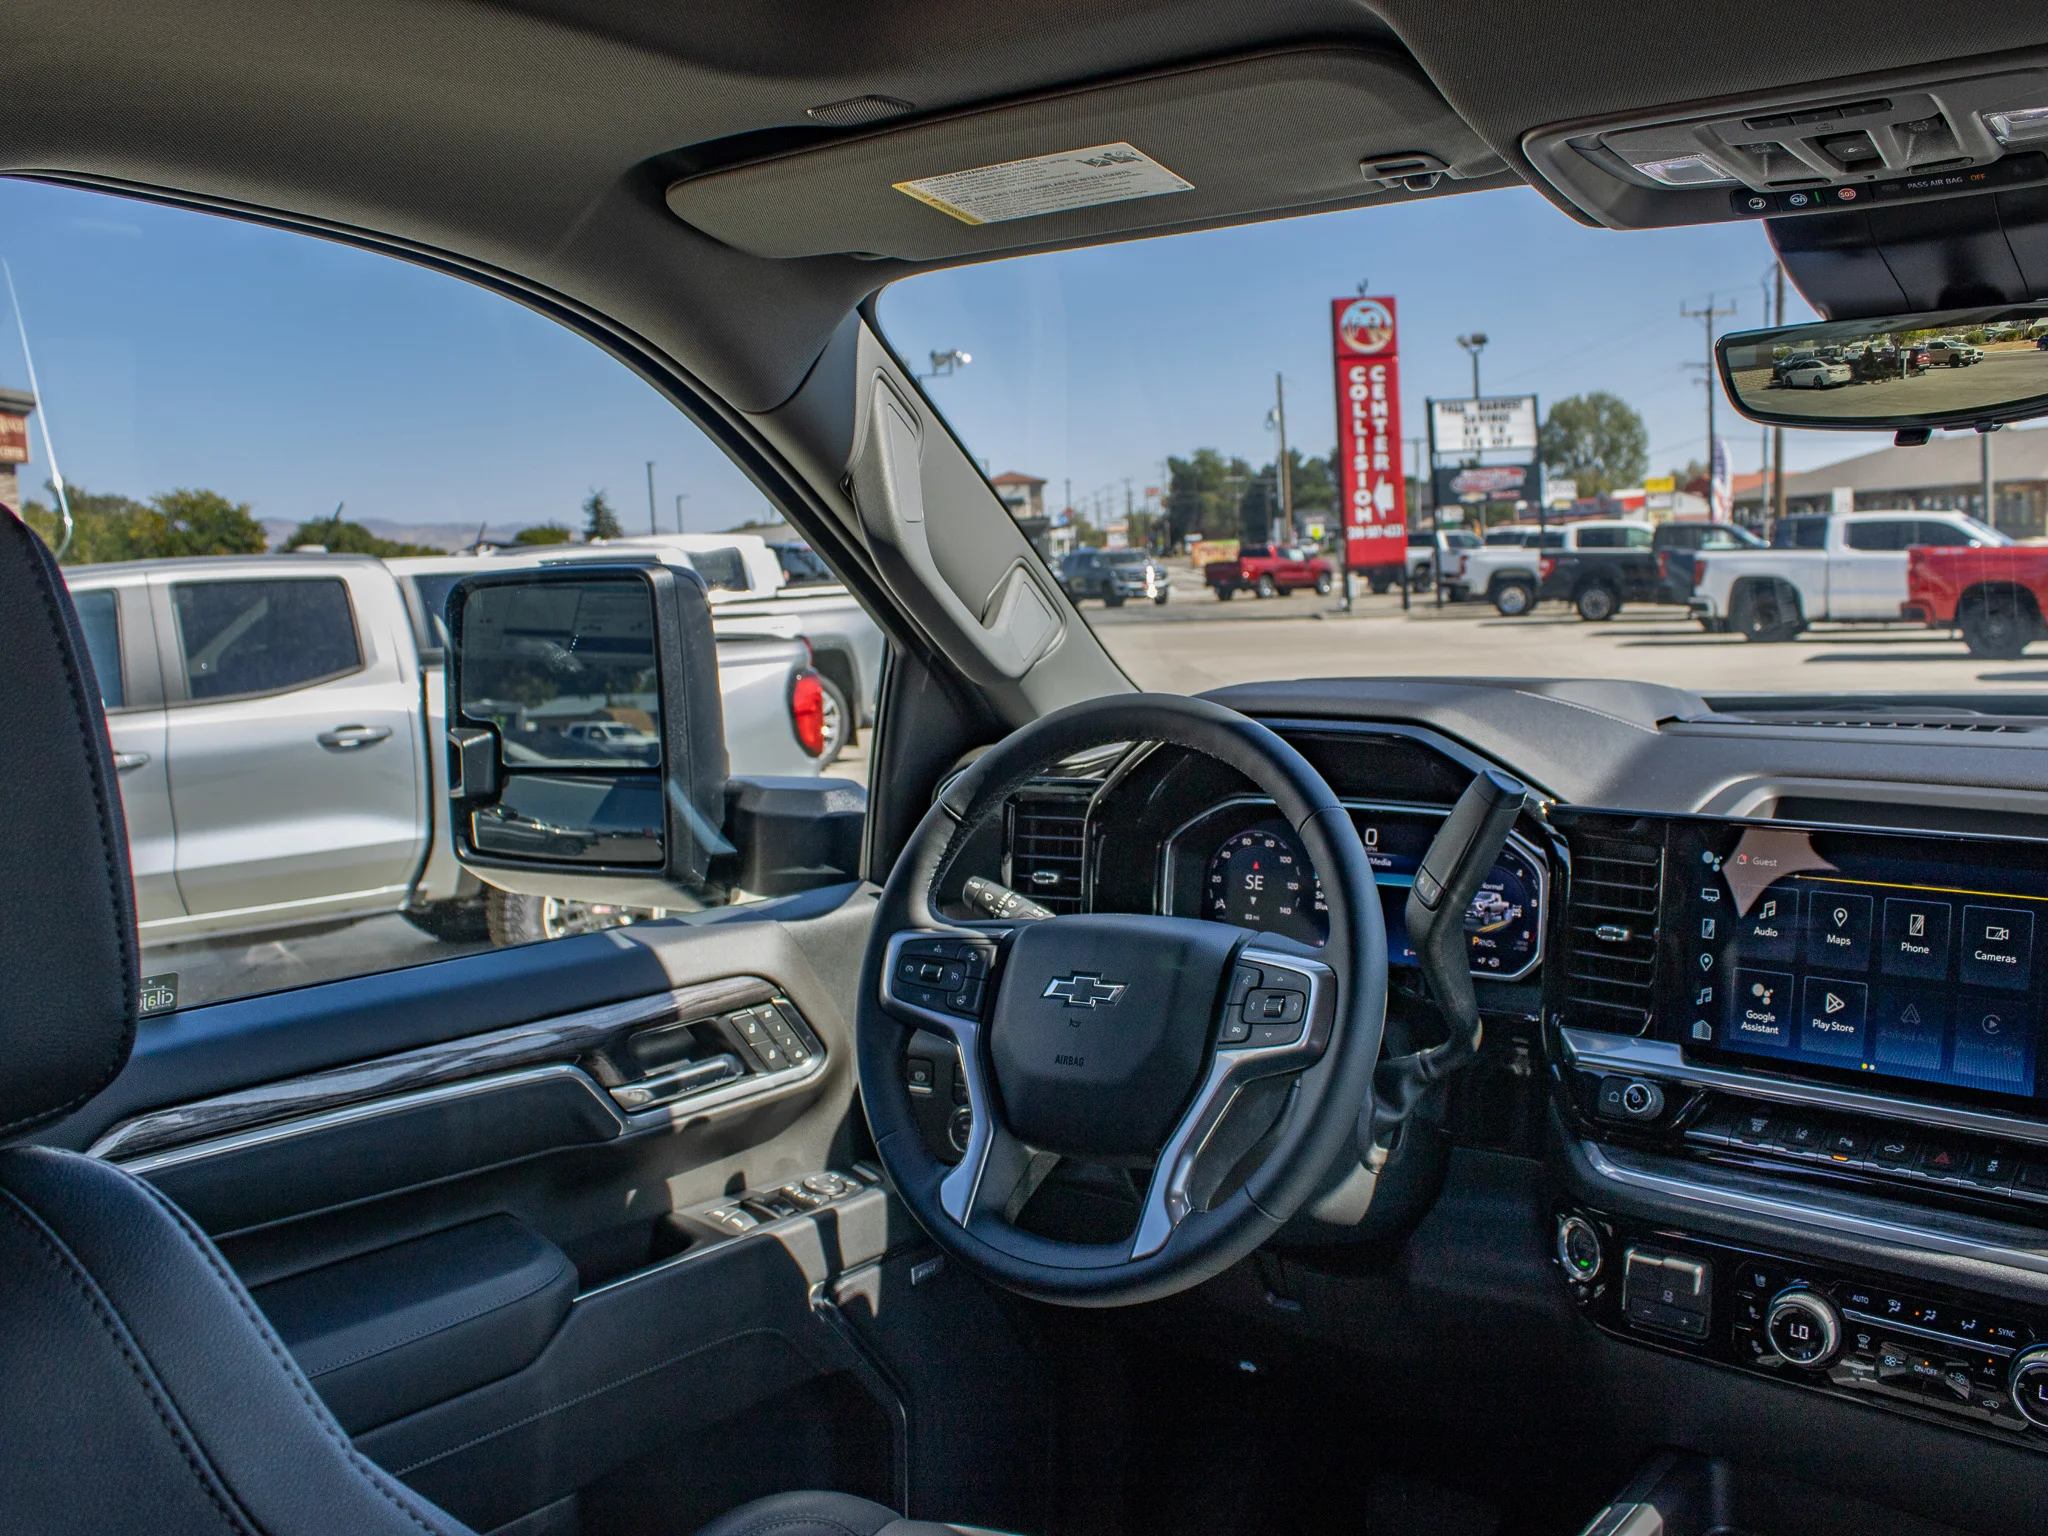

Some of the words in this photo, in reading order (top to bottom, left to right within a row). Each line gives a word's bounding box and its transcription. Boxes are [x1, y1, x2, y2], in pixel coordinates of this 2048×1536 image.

[1907, 178, 1929, 190] PASS
[1930, 176, 1945, 188] AIR
[1946, 175, 1963, 186] BAG
[1970, 173, 1986, 182] OFF
[1839, 190, 1855, 199] SOS
[1370, 364, 1390, 472] CENTER
[1349, 365, 1373, 524] COLLISION
[1365, 828, 1378, 846] 0
[1221, 851, 1231, 859] 40
[1280, 856, 1292, 864] 100
[1752, 856, 1778, 867] Guest
[1211, 875, 1222, 883] 20
[1244, 874, 1264, 891] SE
[1287, 882, 1299, 890] 120
[1531, 899, 1538, 908] 5
[1280, 907, 1292, 915] 140
[1522, 931, 1530, 939] 6
[1753, 926, 1778, 937] Audio
[1826, 934, 1851, 947] Maps
[1901, 942, 1930, 954] Phone
[1975, 950, 2017, 964] Cameras
[1746, 1010, 1775, 1022] Google
[1741, 1021, 1779, 1035] Assistant
[1812, 1019, 1831, 1032] Play
[1831, 1021, 1854, 1033] Store
[1054, 1054, 1084, 1067] AIRBAG
[1852, 1294, 1869, 1304] AUTO
[1998, 1327, 2016, 1338] SYNC
[1914, 1365, 1938, 1376] ON/OFF
[1983, 1367, 1996, 1376] A/C
